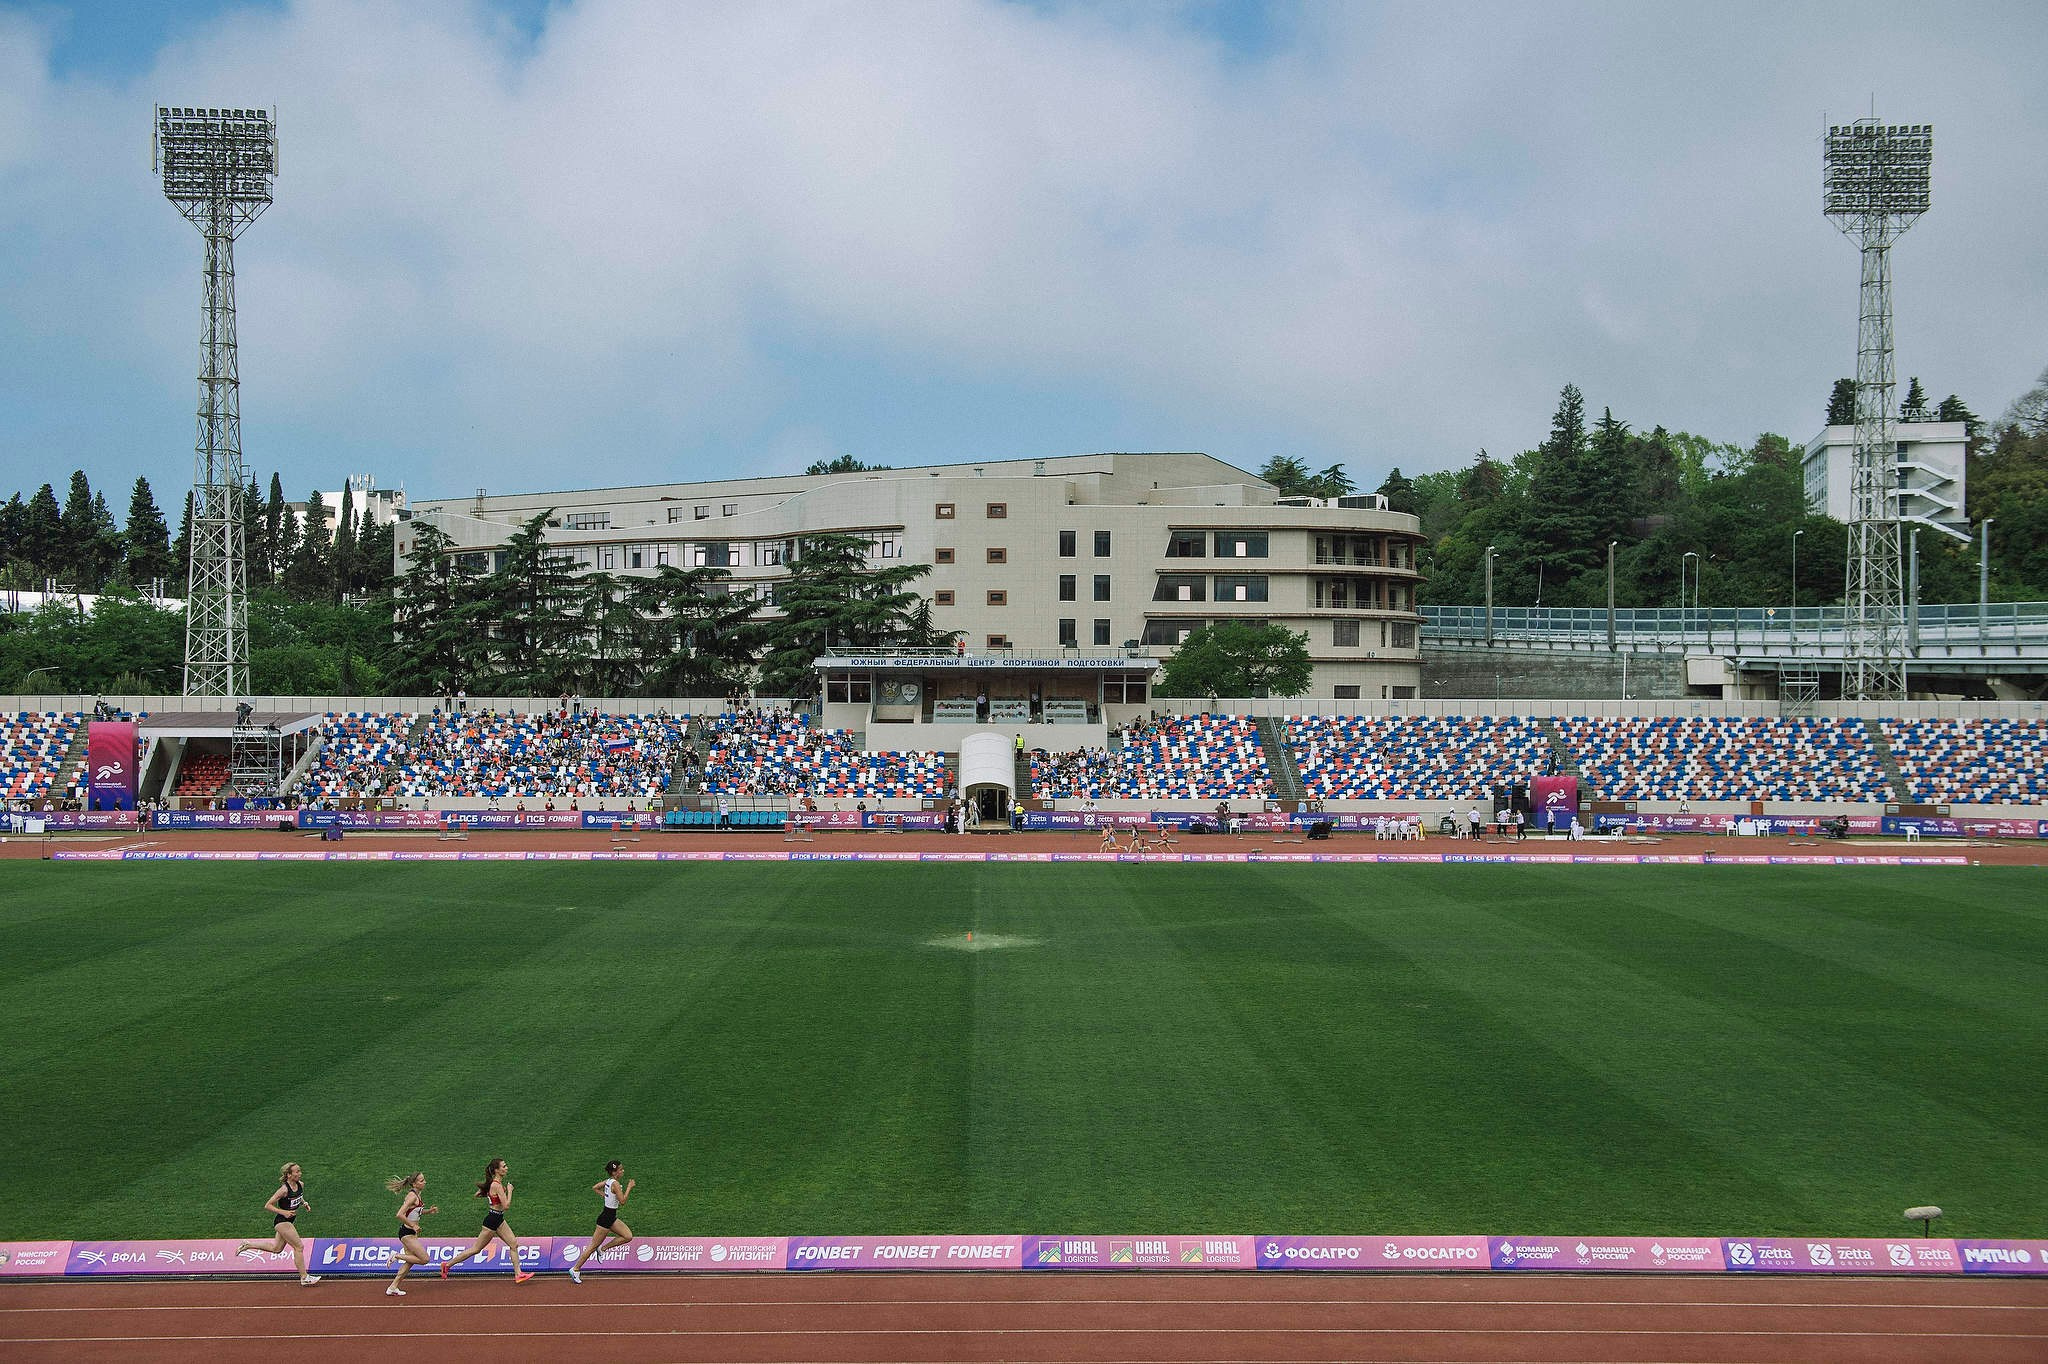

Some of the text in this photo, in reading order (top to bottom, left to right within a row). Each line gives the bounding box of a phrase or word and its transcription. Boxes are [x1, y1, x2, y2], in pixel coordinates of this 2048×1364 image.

[894, 659, 960, 667] ФЕДЕРАЛЬНЫЙ
[968, 660, 995, 668] ЦЕНТР
[1068, 660, 1124, 668] ПОДГОТОВКИ
[634, 814, 651, 822] URAL
[874, 1246, 940, 1258] FONBET
[948, 1246, 1014, 1258] FONBET
[1065, 1241, 1098, 1254] URAL
[1136, 1241, 1169, 1254] URAL
[1206, 1241, 1239, 1254] URAL
[112, 1253, 145, 1262] ВФЛА
[190, 1252, 223, 1261] ВФЛА
[351, 1247, 391, 1261] ПСБ
[655, 1252, 702, 1260] ЛИЗИНГ
[728, 1252, 775, 1260] ЛИЗИНГ
[795, 1247, 863, 1259] FONBET
[1285, 1248, 1360, 1258] ФОСАГРО
[1404, 1248, 1478, 1259] ФОСАГРО
[1758, 1248, 1793, 1258] zetta
[1838, 1249, 1872, 1259] zetta
[1917, 1249, 1952, 1259] zetta
